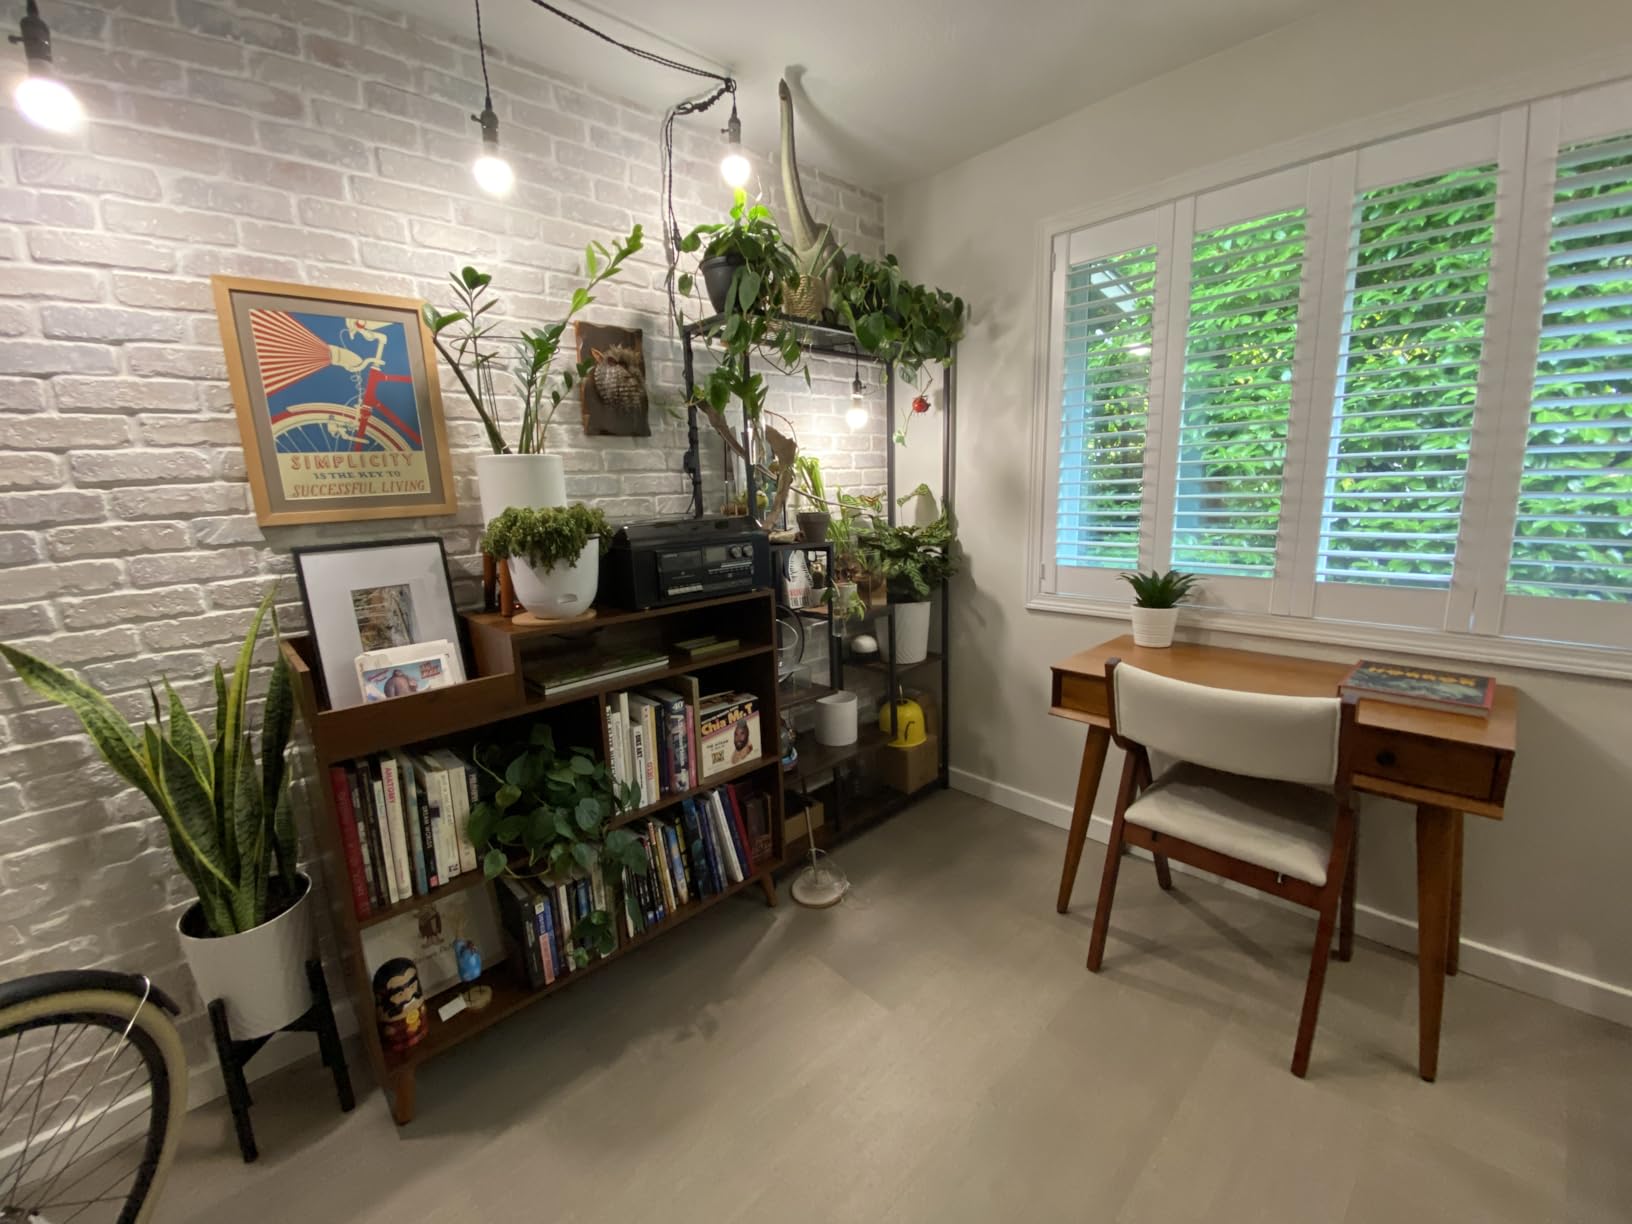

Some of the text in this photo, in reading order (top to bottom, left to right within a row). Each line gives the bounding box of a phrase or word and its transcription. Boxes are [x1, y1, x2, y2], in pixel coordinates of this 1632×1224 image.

[291, 453, 412, 470] SIMPLICITY
[313, 472, 326, 480] IS
[292, 479, 426, 497] SUCCESSFUL LIVING
[701, 718, 727, 736] Chia
[727, 709, 746, 723] Mr.
[744, 702, 754, 715] T
